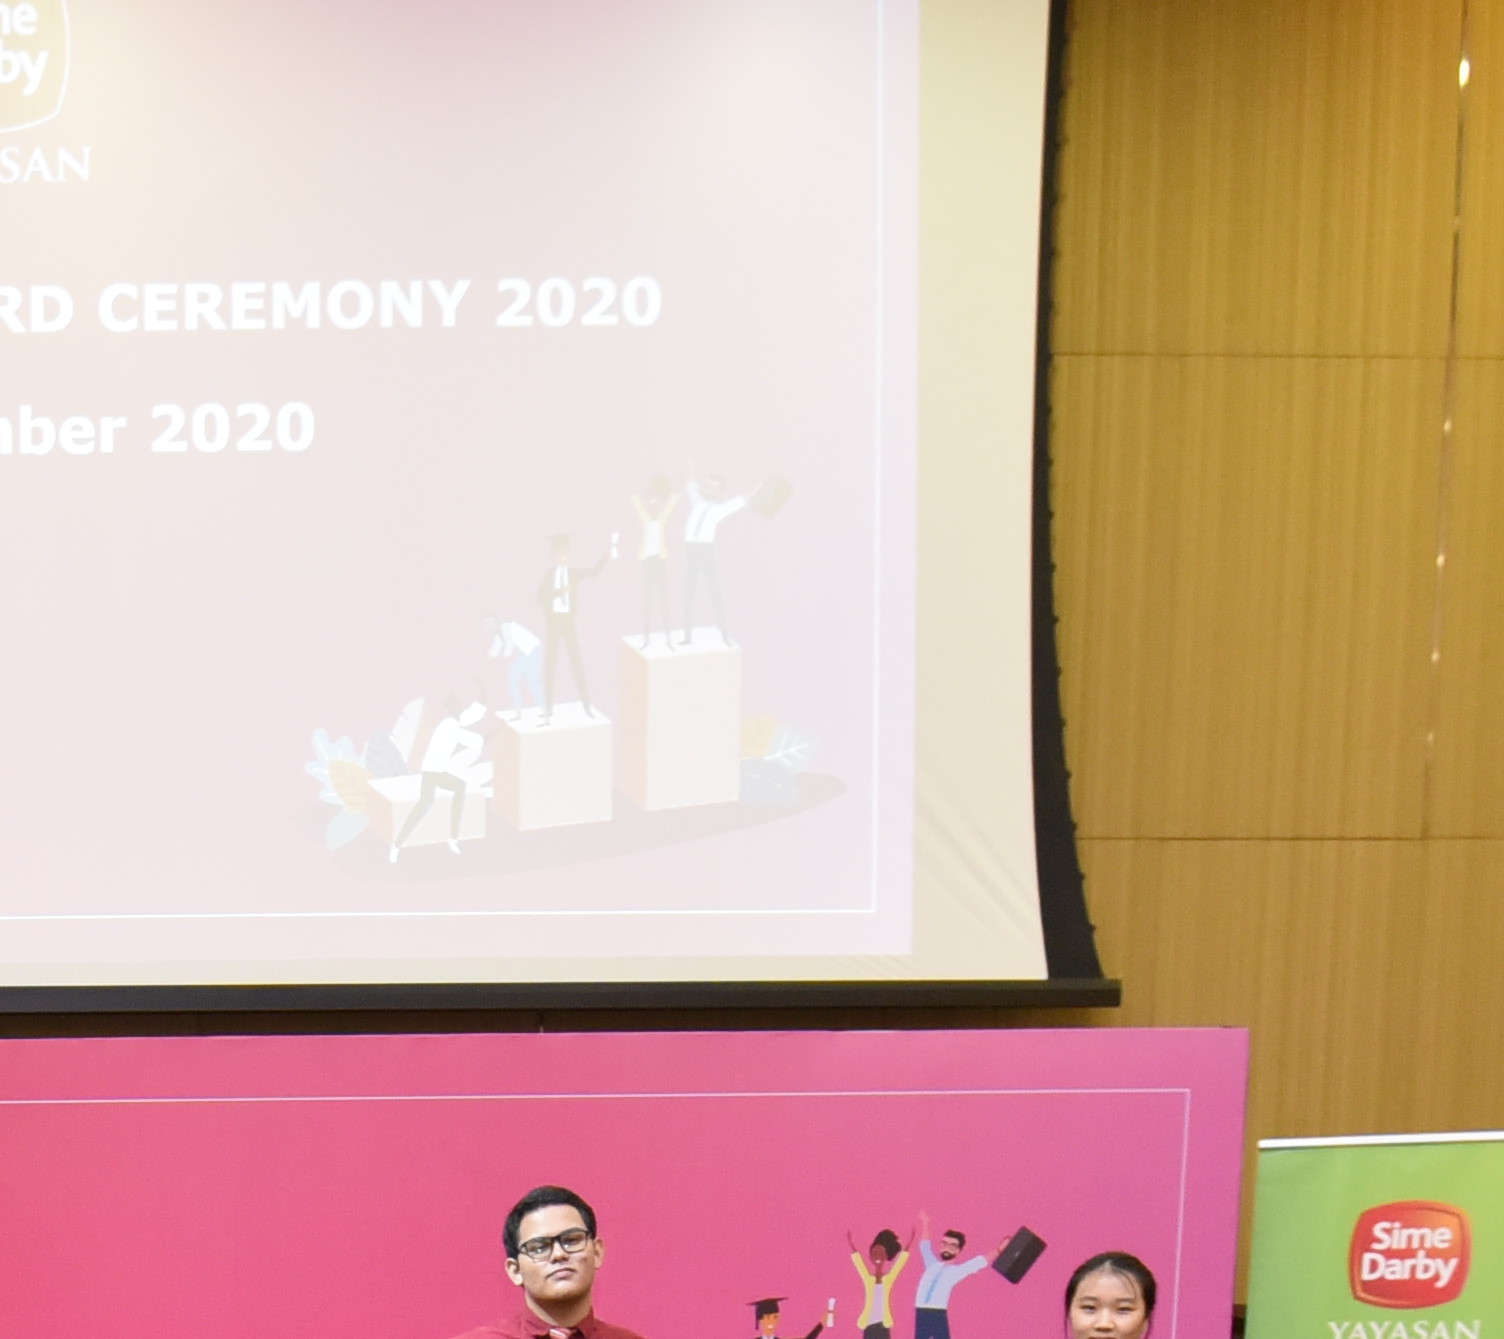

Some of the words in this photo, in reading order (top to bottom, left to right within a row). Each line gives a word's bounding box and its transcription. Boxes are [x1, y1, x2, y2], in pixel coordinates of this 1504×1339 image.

[98, 279, 472, 332] CEREMONY
[495, 276, 662, 327] 2020
[151, 402, 315, 453] 2020
[1370, 1221, 1453, 1250] Sime
[1360, 1250, 1459, 1288] Darby
